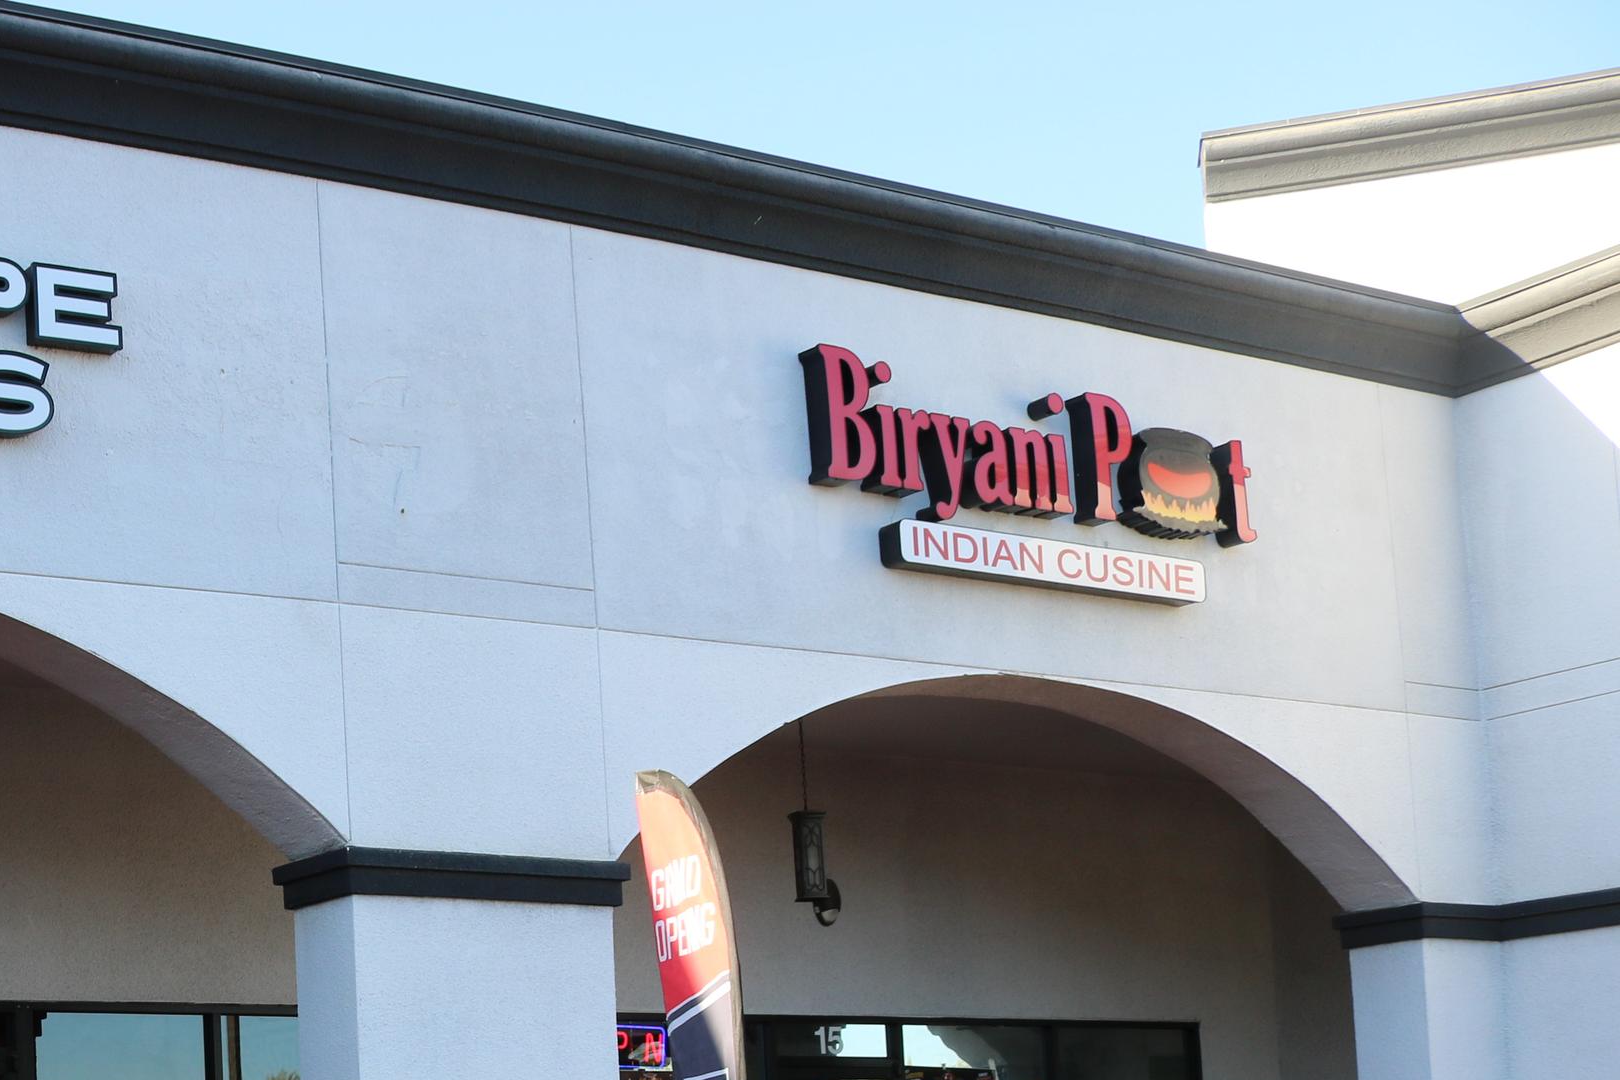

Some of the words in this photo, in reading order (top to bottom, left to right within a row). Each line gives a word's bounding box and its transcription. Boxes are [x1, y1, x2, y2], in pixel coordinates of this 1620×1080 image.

[798, 343, 1074, 520] Biryani
[912, 526, 1045, 574] INDIAN
[1058, 548, 1196, 597] CUSINE
[651, 855, 702, 911] GRND
[655, 902, 716, 963] OPENG
[814, 1026, 845, 1055] 15
